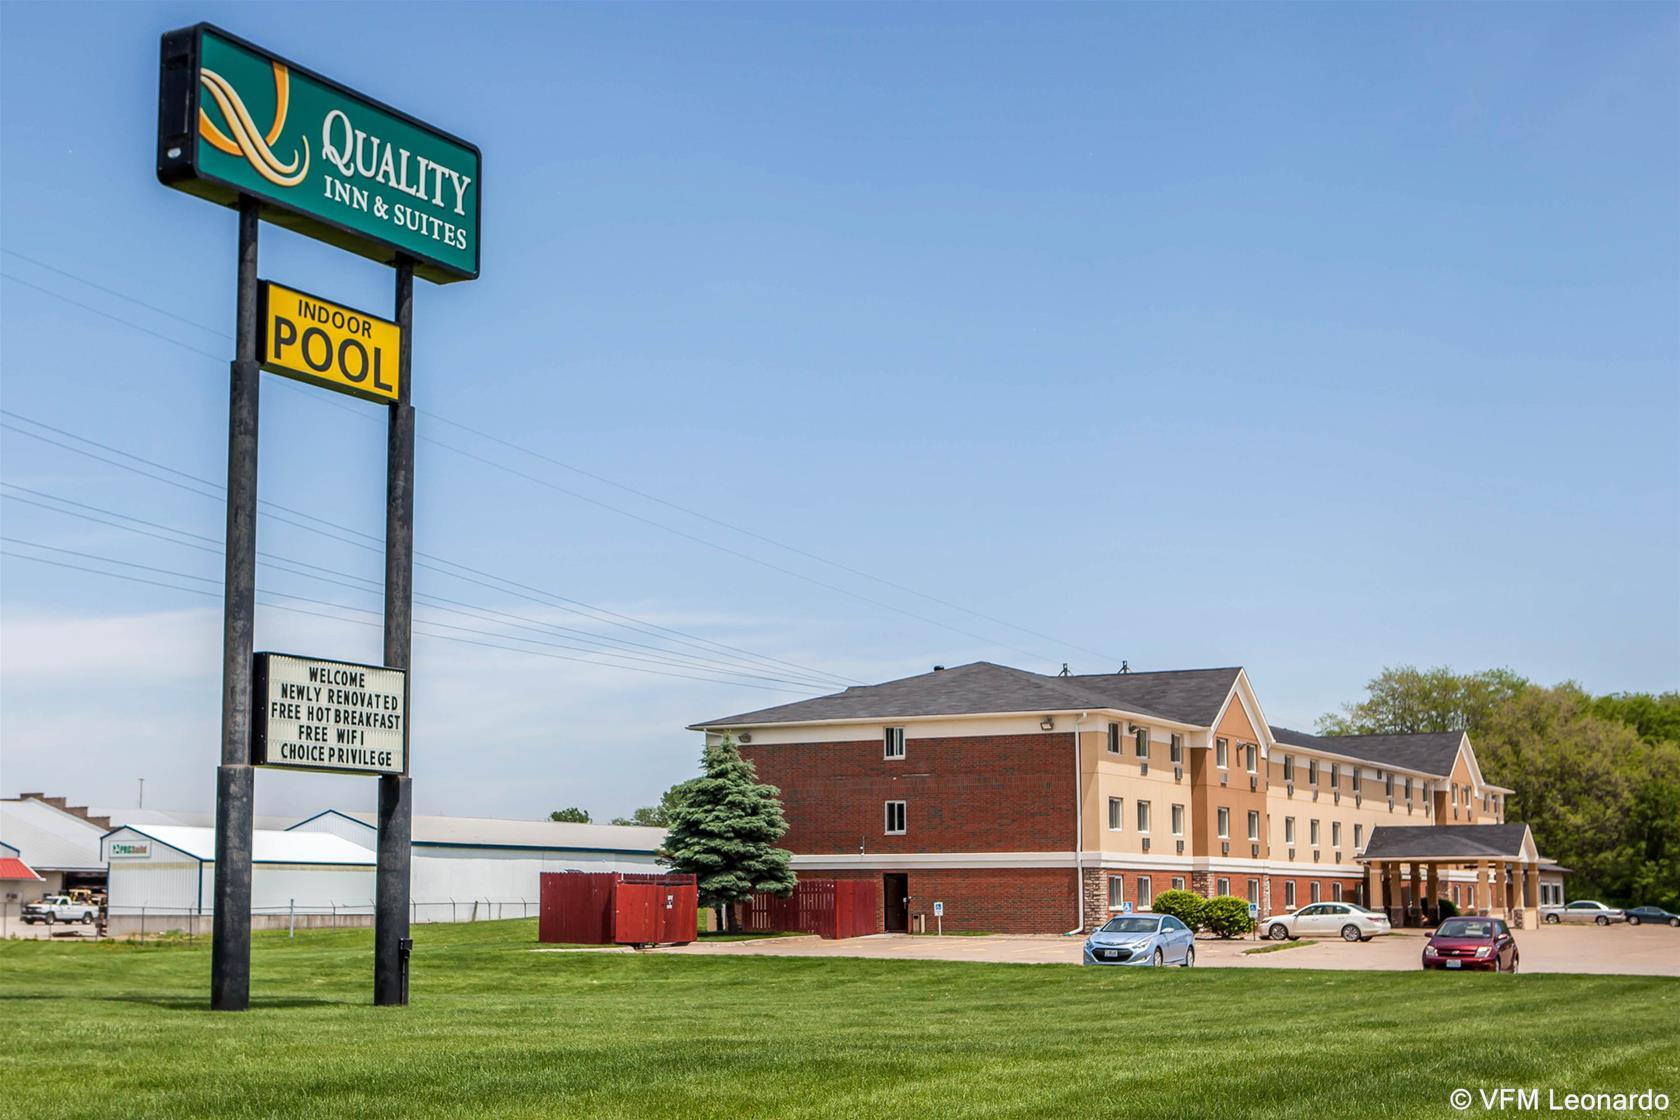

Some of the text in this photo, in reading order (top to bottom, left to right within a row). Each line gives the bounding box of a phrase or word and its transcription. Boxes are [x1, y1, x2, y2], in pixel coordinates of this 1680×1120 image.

[322, 109, 471, 216] QUALITY
[324, 174, 467, 250] INN & SUITES
[298, 299, 372, 339] INDOOR
[274, 315, 393, 392] POOL
[309, 666, 365, 688] WELCOME
[281, 683, 398, 711] NEWLY RENOVATED
[271, 702, 401, 730] FREE HOT BREAKFAST
[298, 724, 364, 746] FREE WIFI
[281, 743, 392, 767] CHOICE PRIVILEGE
